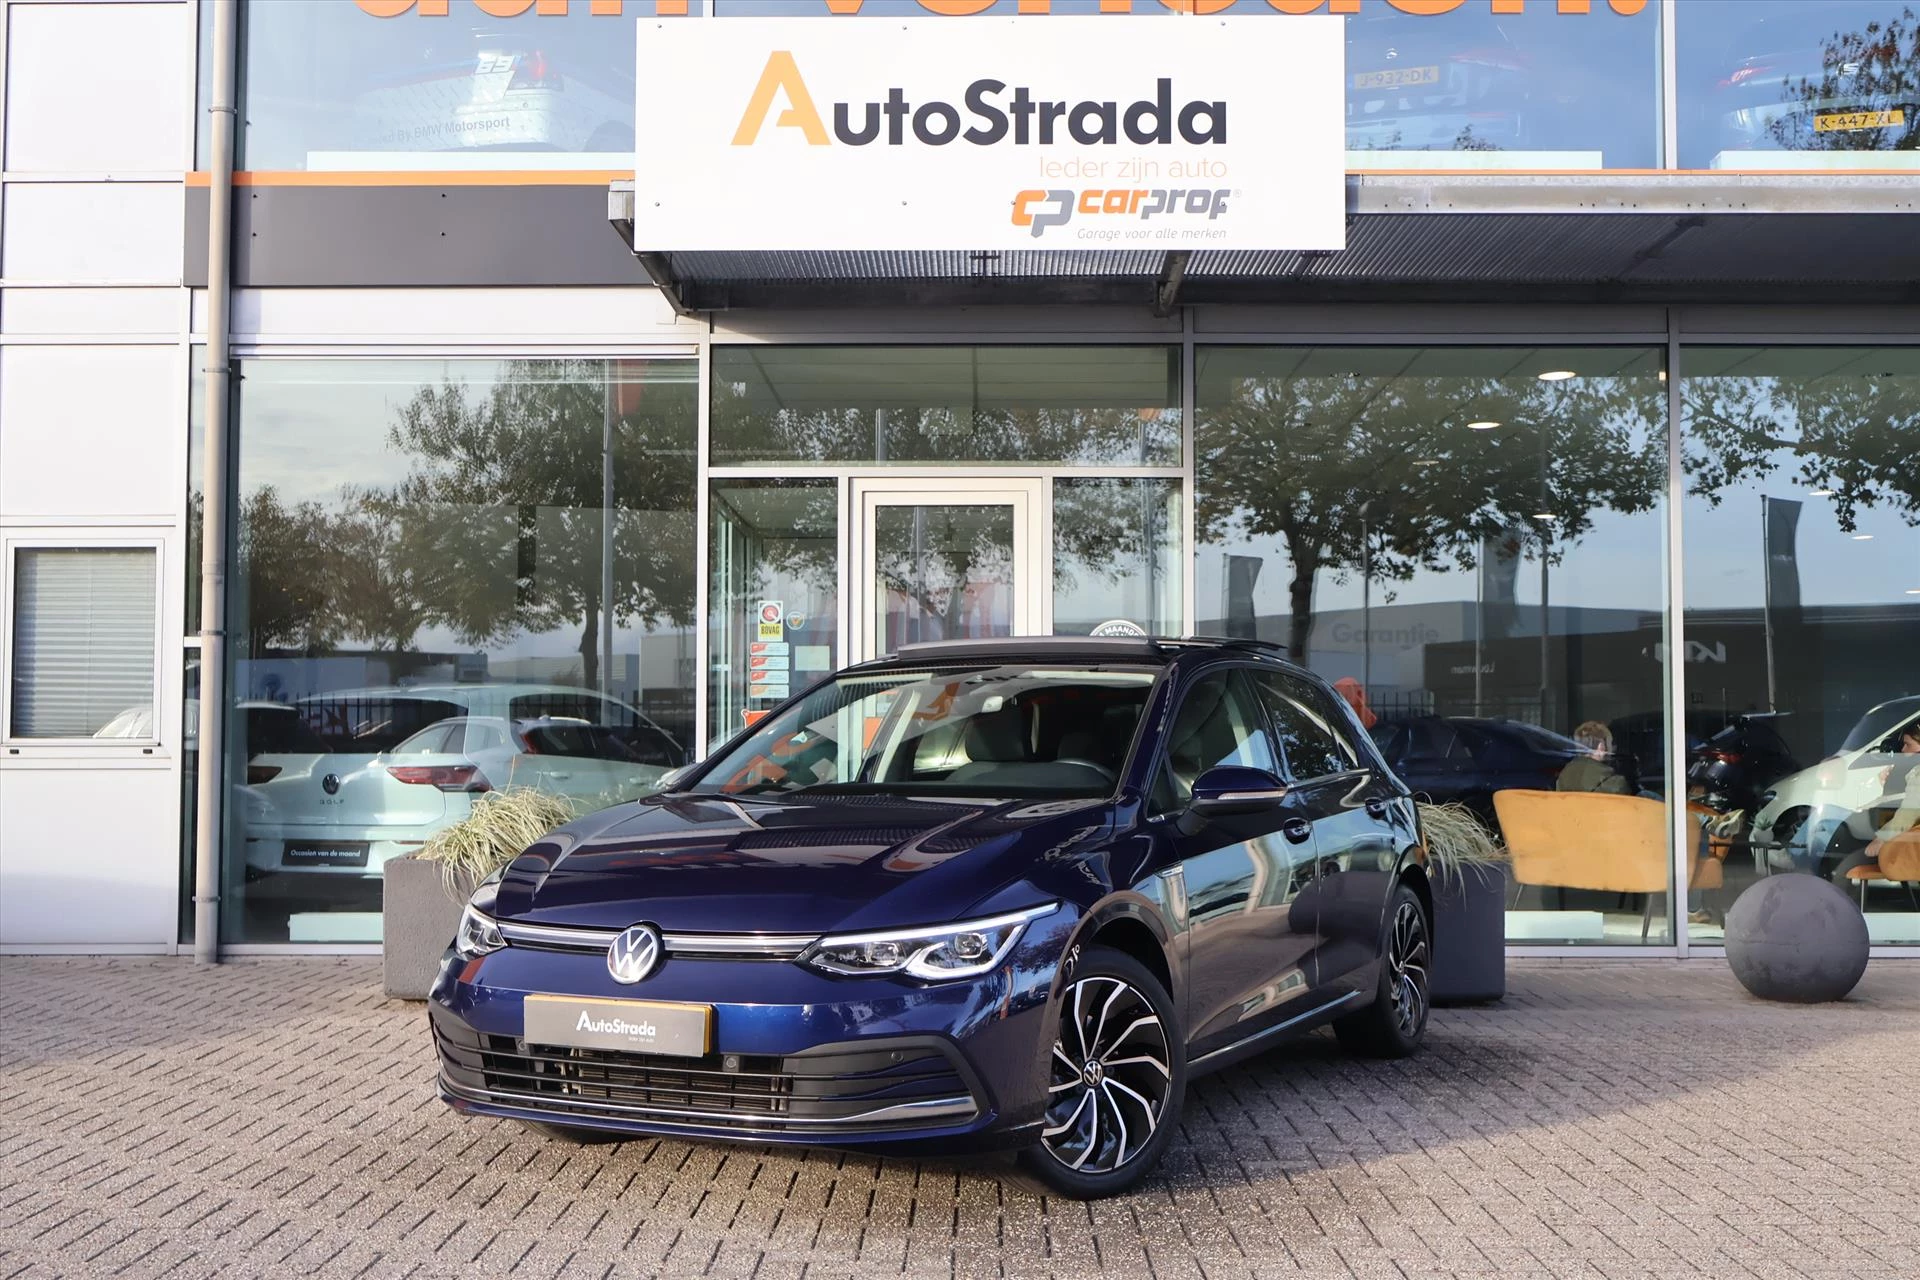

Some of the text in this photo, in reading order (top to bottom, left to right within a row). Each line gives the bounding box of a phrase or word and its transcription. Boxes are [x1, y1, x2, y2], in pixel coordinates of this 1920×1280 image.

[1360, 67, 1432, 87] J-932-DK
[731, 51, 1227, 146] AutoStrada
[446, 116, 511, 133] Motorsport
[1820, 114, 1896, 128] K-447-XL
[1039, 156, 1228, 183] Ieder zijn auto
[1077, 228, 1227, 242] Garage voor alle merken
[760, 625, 780, 635] BOVAG
[1331, 622, 1440, 645] Garantie
[290, 849, 316, 857] Occasion
[575, 1010, 656, 1036] AutoStrada
